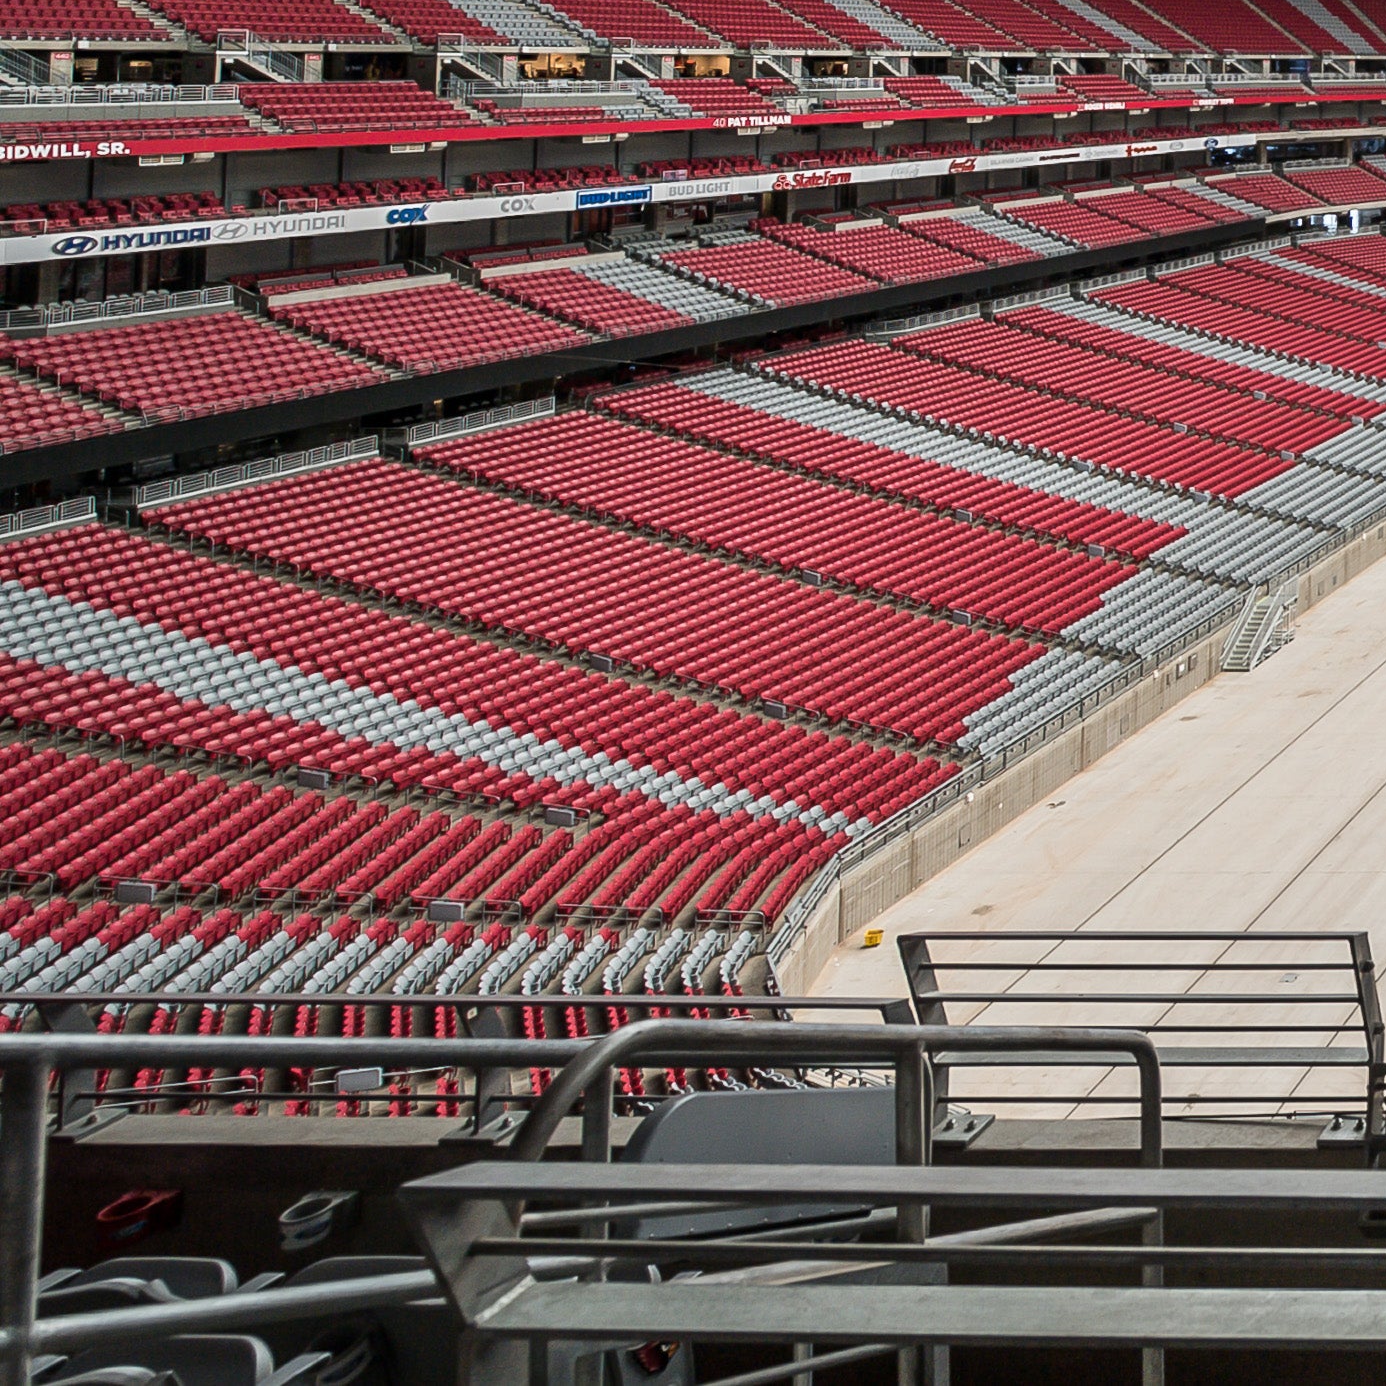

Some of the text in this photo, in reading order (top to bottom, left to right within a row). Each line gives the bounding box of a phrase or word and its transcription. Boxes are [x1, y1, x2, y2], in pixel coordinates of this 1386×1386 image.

[712, 115, 792, 128] 40 PAT TILLMAN
[97, 141, 131, 156] SR.
[668, 181, 730, 197] BUD LIGHT
[500, 198, 535, 213] COX
[386, 203, 430, 225] COX
[253, 214, 345, 236] HYUNDAI
[100, 226, 211, 251] HYUNDAI
